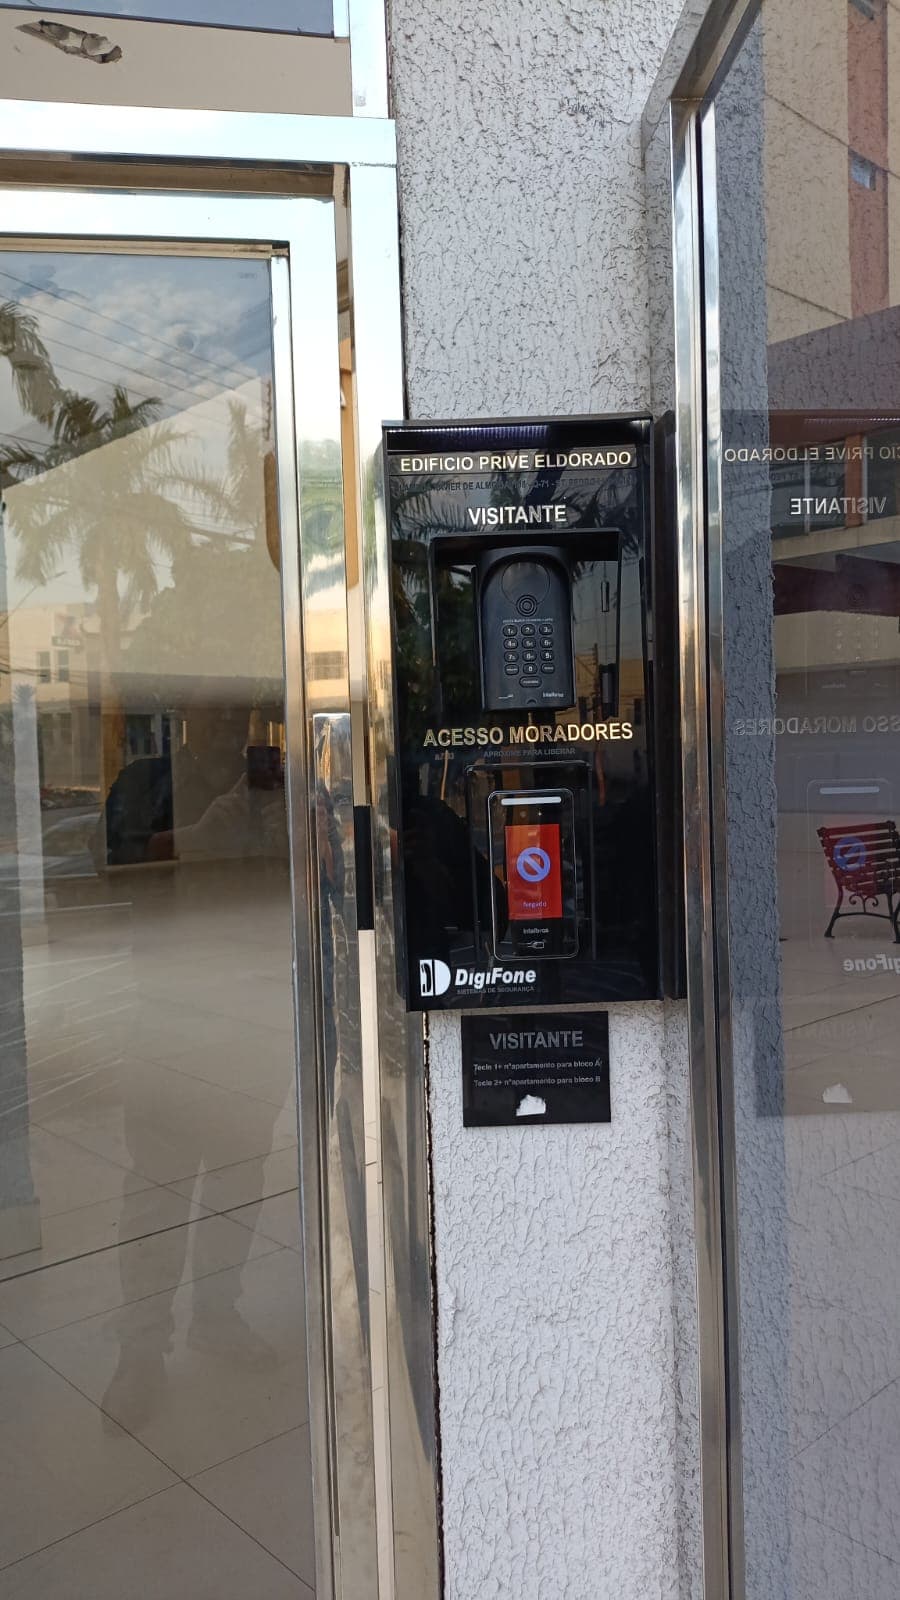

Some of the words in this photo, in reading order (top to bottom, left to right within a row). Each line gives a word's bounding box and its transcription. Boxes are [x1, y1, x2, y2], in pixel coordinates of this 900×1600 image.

[400, 456, 474, 472] EDIFICIO
[479, 455, 529, 469] PRIVE
[534, 451, 631, 468] ELDORADO
[468, 504, 567, 525] VISITANTE
[423, 727, 504, 747] ACESSO
[509, 722, 634, 743] MORADORES
[454, 967, 537, 989] DigiFone
[489, 1030, 584, 1050] VISITANTE
[556, 1062, 573, 1071] para
[573, 1060, 594, 1068] bloco
[556, 1077, 573, 1085] para
[573, 1075, 594, 1083] bloco
